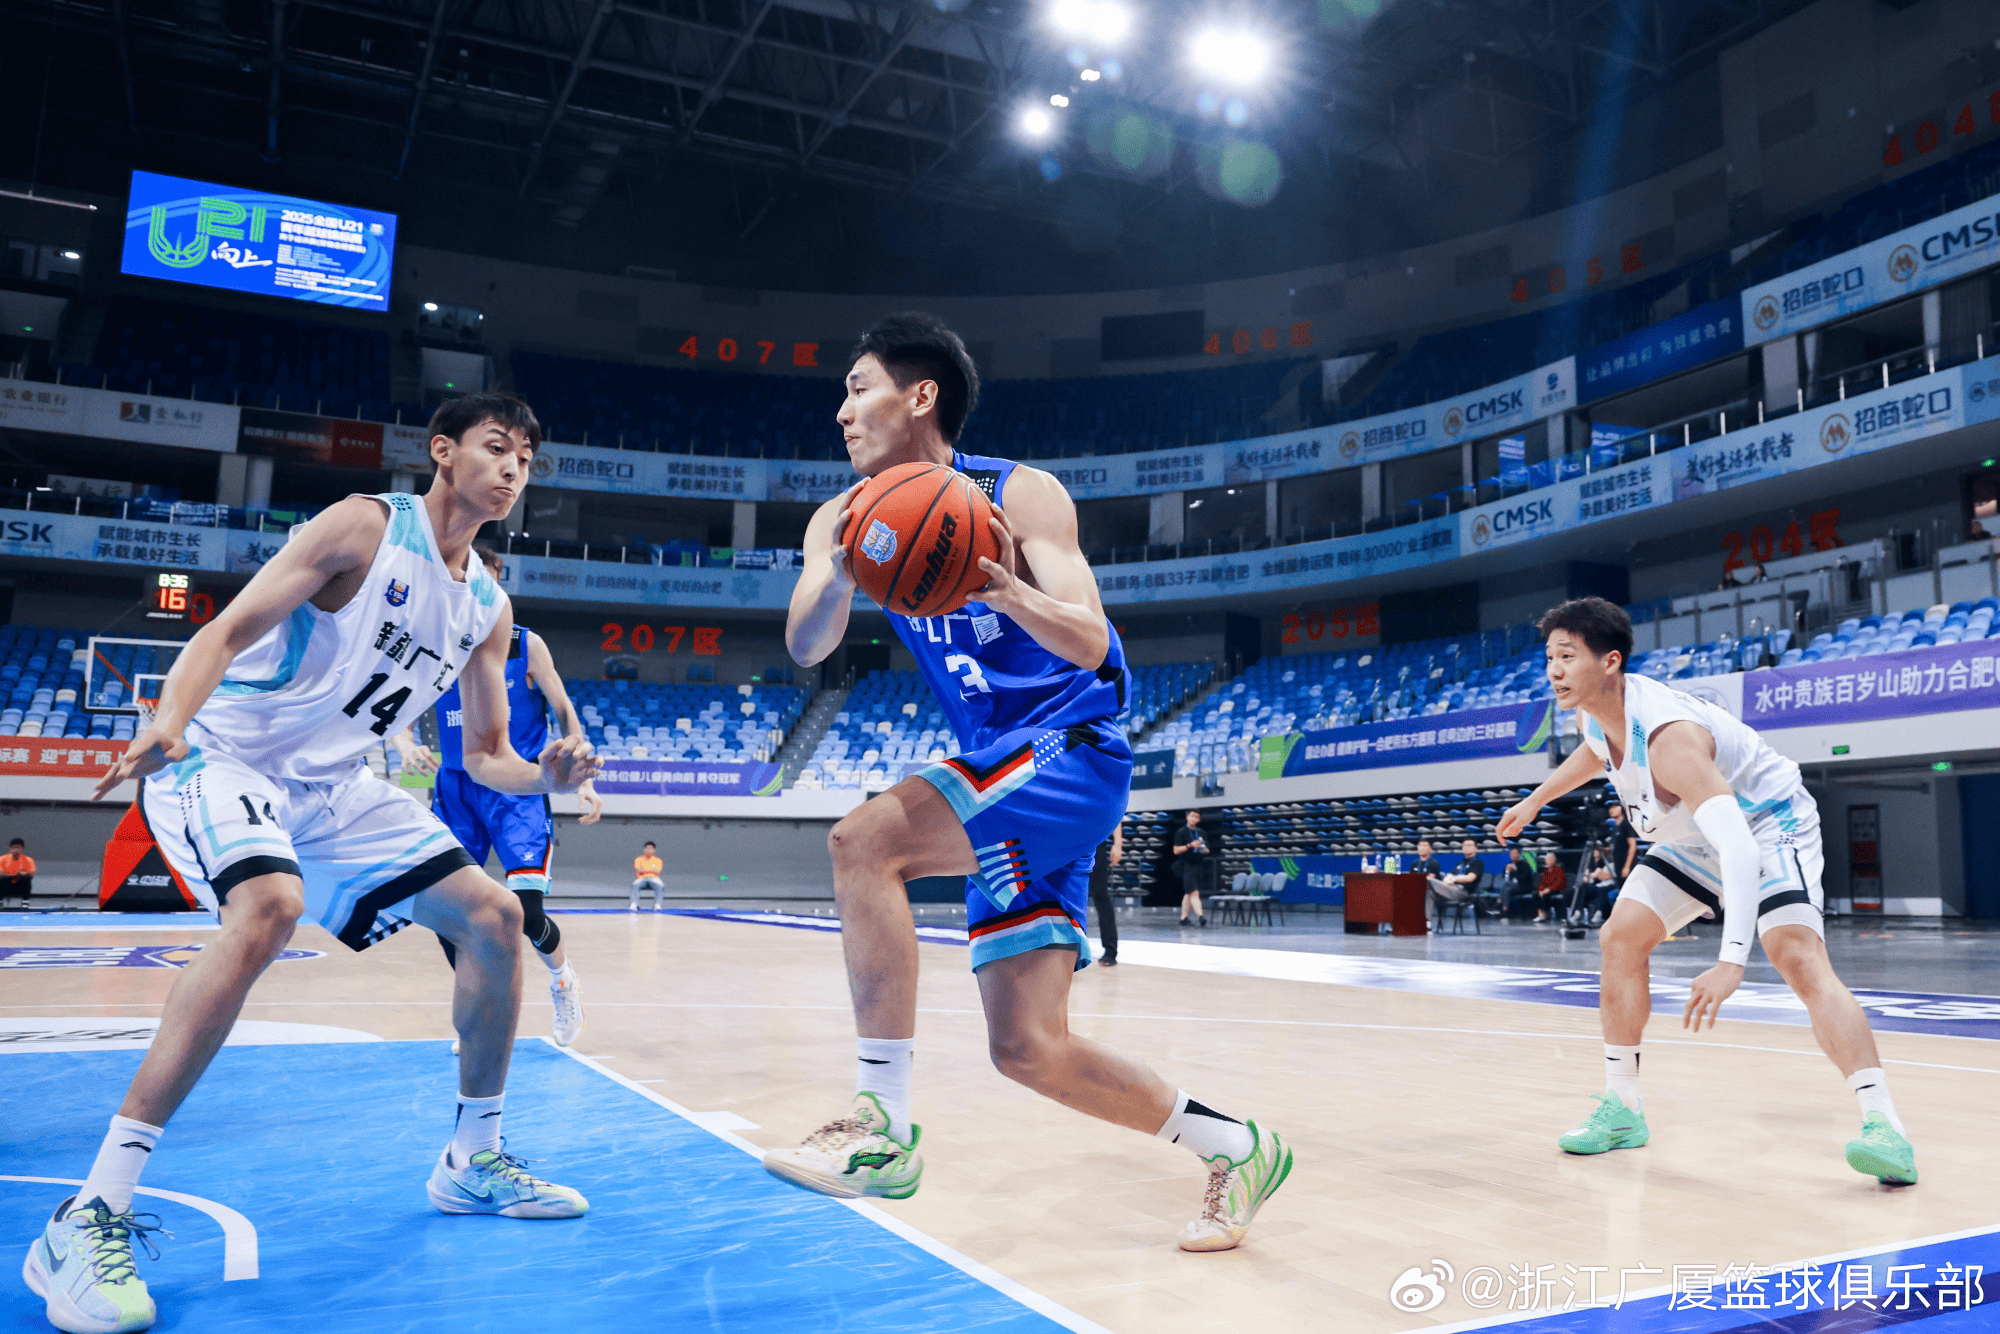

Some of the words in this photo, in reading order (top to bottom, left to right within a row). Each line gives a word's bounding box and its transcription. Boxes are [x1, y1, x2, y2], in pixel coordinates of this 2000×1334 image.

[1783, 266, 1865, 315] 招商蛇口
[679, 336, 819, 366] 407区
[1465, 388, 1523, 423] CMSK
[1855, 386, 1951, 436] 招商蛇口
[1363, 419, 1426, 448] 招商蛇口
[557, 455, 634, 479] 招商蛇口
[667, 461, 745, 479] 赋能城市生长
[1047, 468, 1107, 485] 商蛇口
[1579, 465, 1652, 498] 赋能城市生长
[667, 476, 744, 494] 承载美好生活
[1493, 498, 1553, 532] CMSK
[1580, 486, 1652, 520] 承载美好生活
[99, 524, 201, 547] 赋能城市生长
[98, 542, 199, 565] 承载美好生活
[1097, 575, 1140, 591] 品服务
[601, 622, 724, 656] 207区
[1281, 603, 1381, 643] 205区
[945, 654, 993, 702] 3
[342, 672, 412, 736] 14
